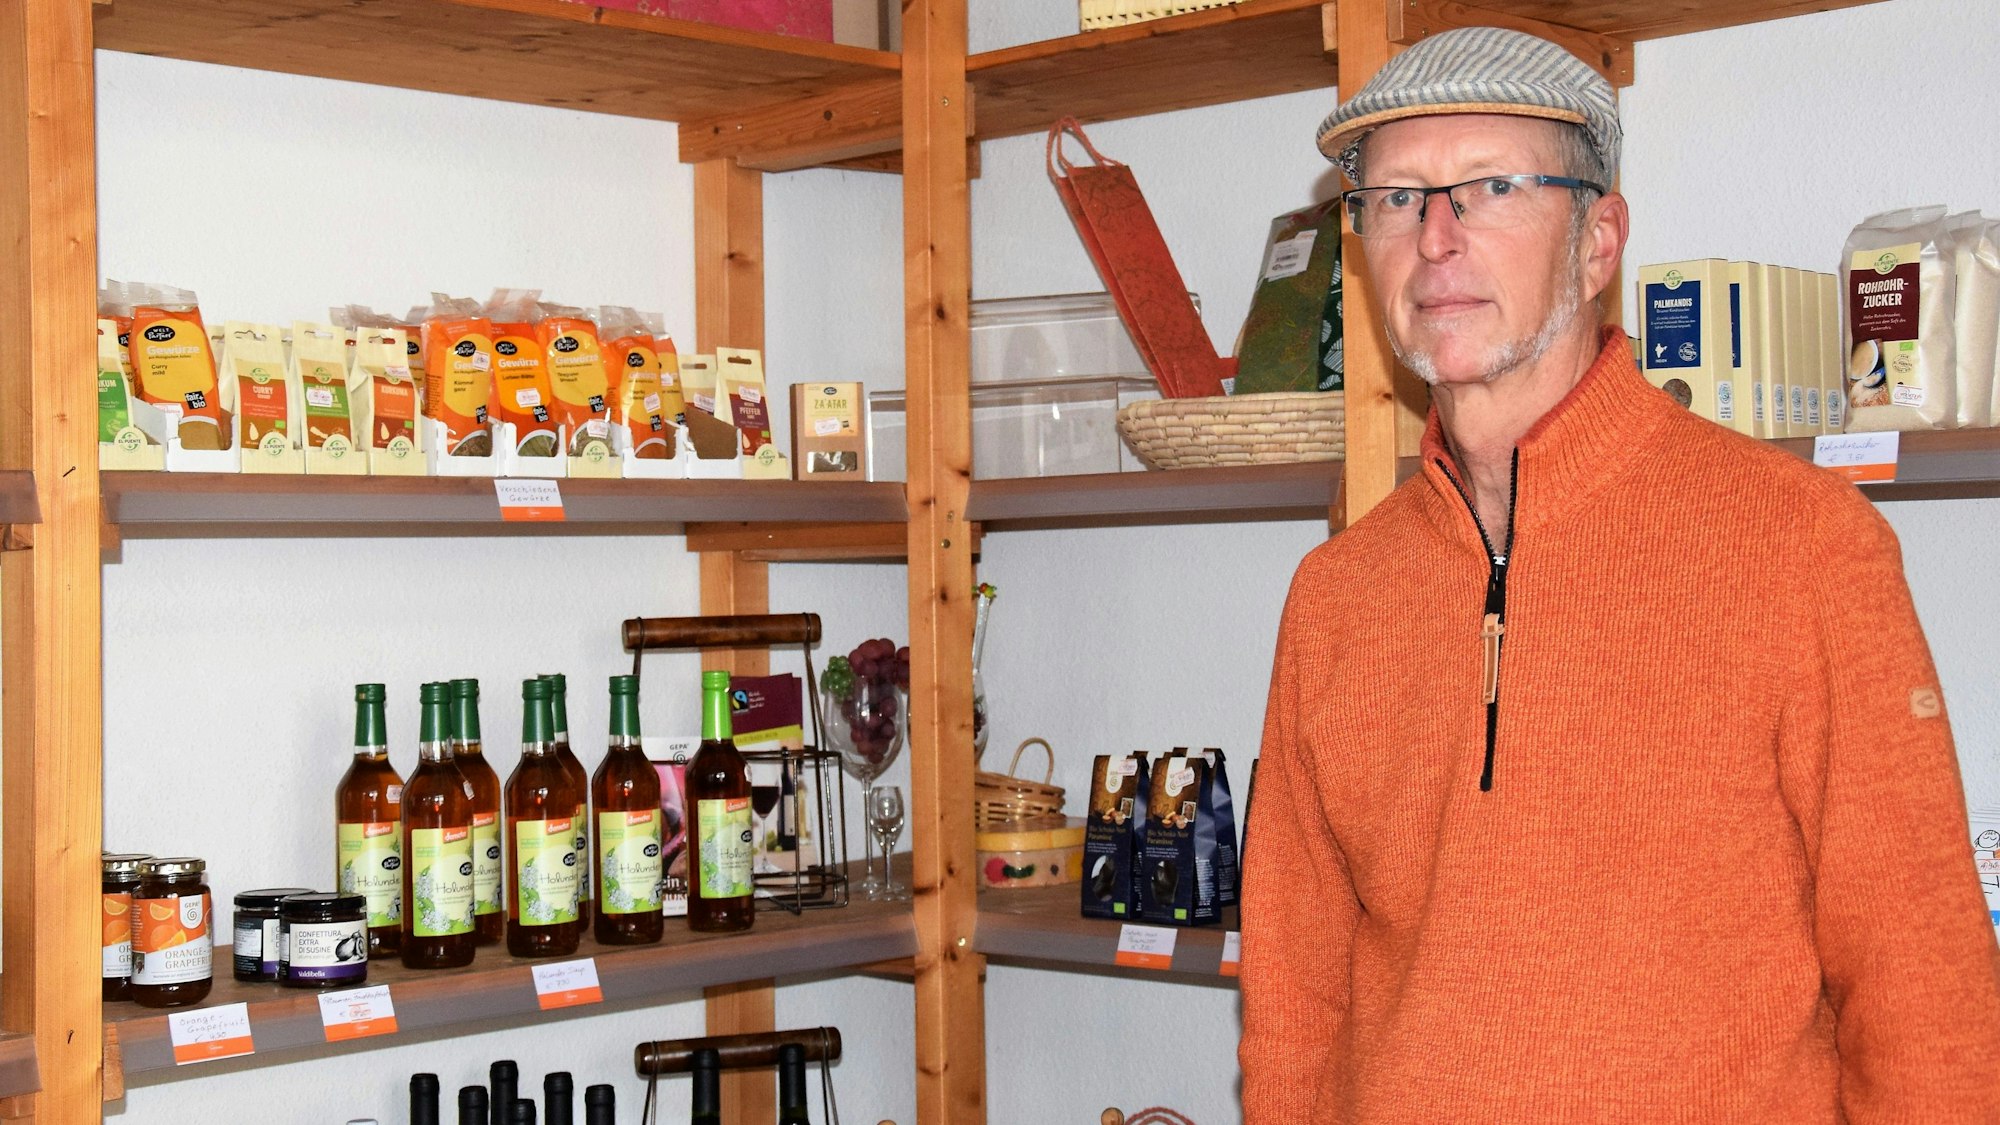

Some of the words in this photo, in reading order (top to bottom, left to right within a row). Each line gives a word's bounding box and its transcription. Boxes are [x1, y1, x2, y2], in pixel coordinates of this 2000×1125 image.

[1858, 278, 1909, 294] ROHROHR-
[1654, 298, 1692, 308] PALMKANDIS
[1863, 293, 1902, 308] ZUCKER
[147, 331, 174, 340] Partner
[192, 400, 206, 408] bio
[298, 930, 342, 938] CONFETTURA
[165, 947, 207, 959] ORANGE-
